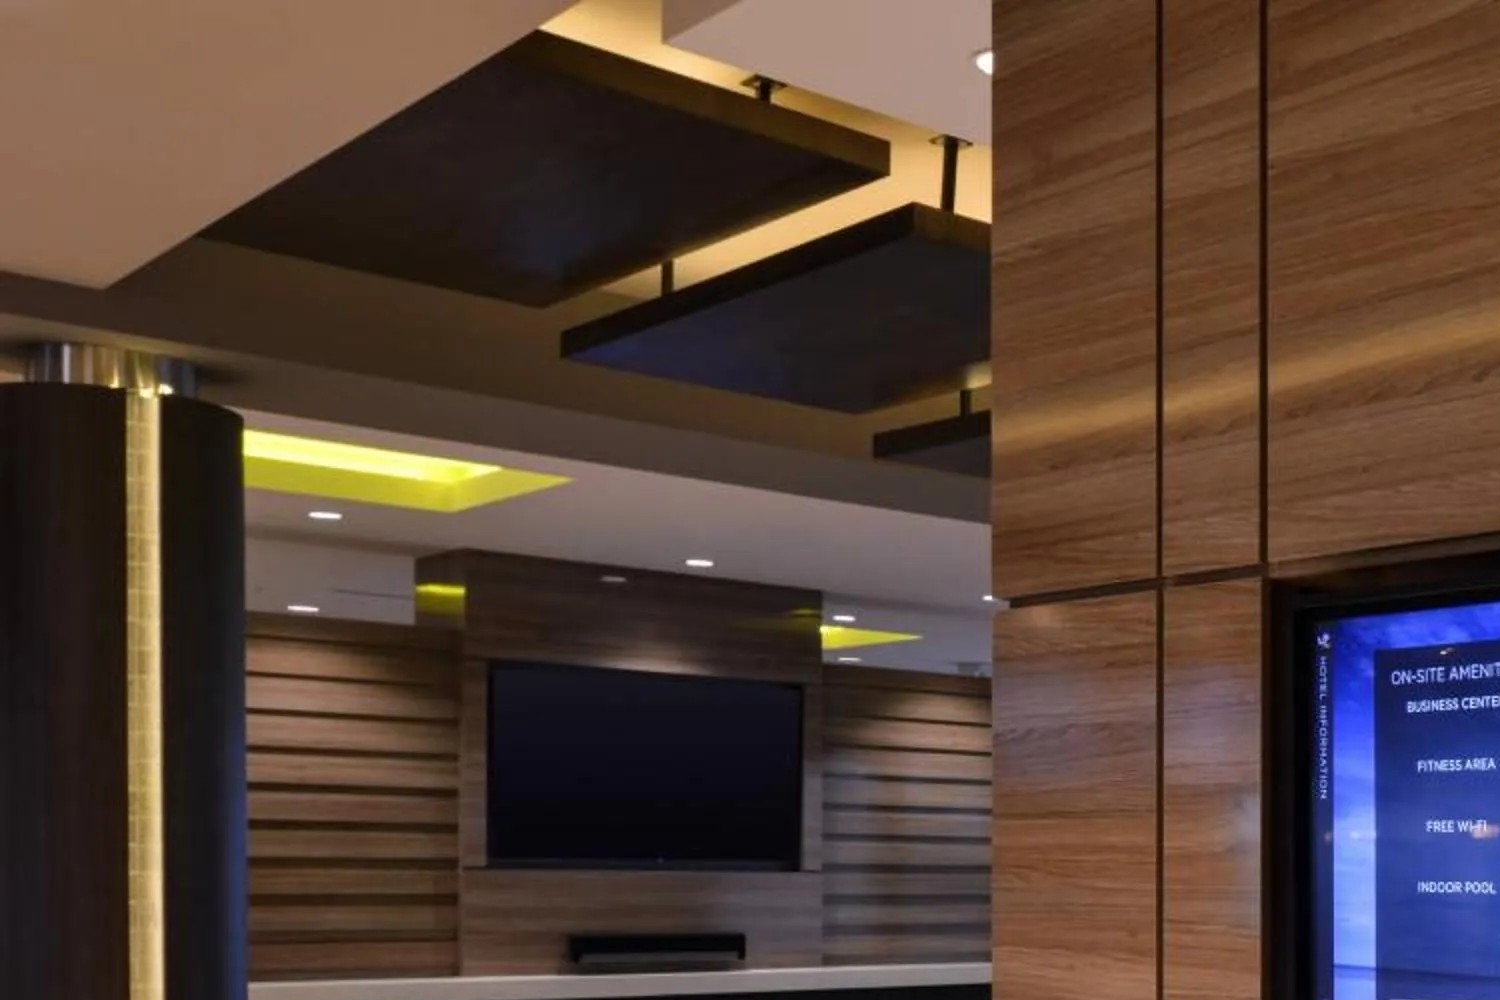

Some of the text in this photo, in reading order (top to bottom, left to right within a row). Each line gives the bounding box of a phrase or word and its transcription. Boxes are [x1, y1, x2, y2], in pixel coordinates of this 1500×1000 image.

[1391, 666, 1446, 685] ON-SITE
[1406, 697, 1460, 713] BUSINESS
[1417, 758, 1497, 773] FITNESS AREA
[1425, 819, 1455, 833] FREE
[1417, 881, 1497, 895] INDOOR POOL
